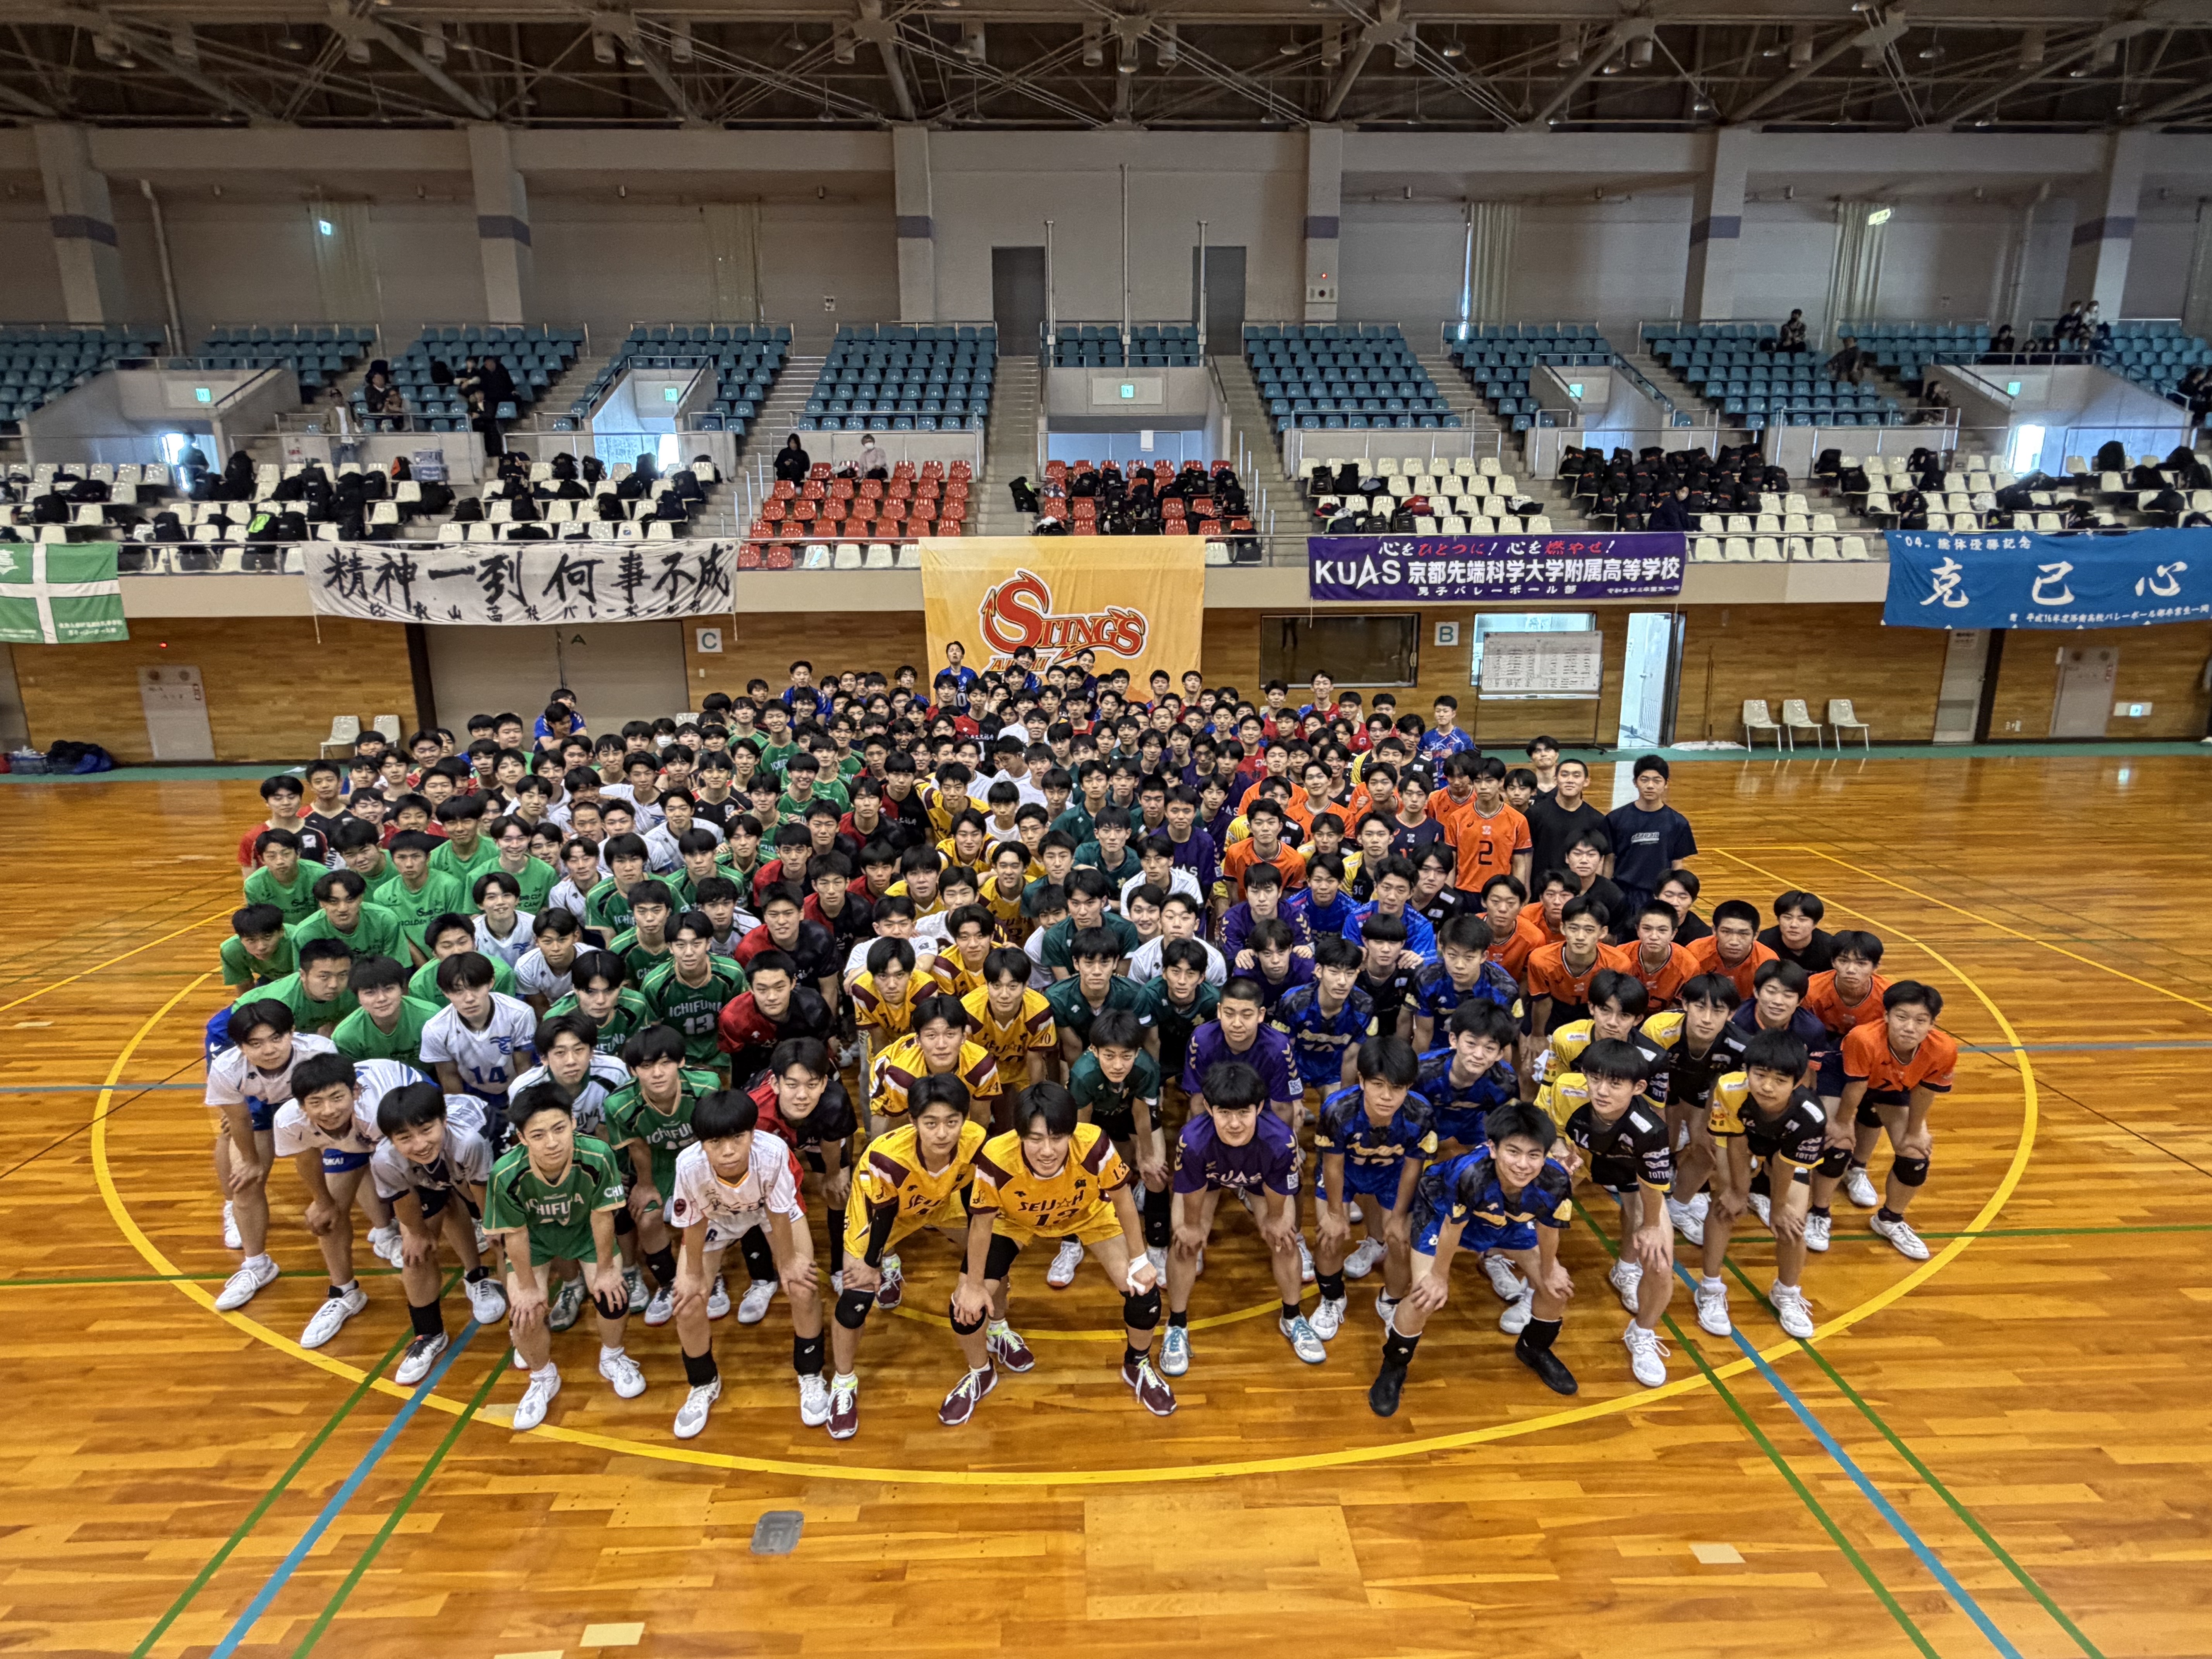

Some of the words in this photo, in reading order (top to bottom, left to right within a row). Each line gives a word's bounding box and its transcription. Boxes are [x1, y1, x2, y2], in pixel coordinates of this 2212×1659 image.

[1316, 554, 1401, 589] KUAS
[1408, 558, 1680, 584] 京都先端科学大学附属高等学校
[1417, 585, 1577, 596] 男子バレーボール部
[981, 569, 1147, 656] STINGS
[571, 634, 587, 646] A
[702, 632, 717, 649] C
[1439, 625, 1454, 642] B
[1479, 840, 1493, 865] 2
[683, 1013, 715, 1035] 13
[469, 1066, 509, 1084] 14
[1574, 1128, 1589, 1149] 14
[525, 1192, 585, 1216] ICHIFUA
